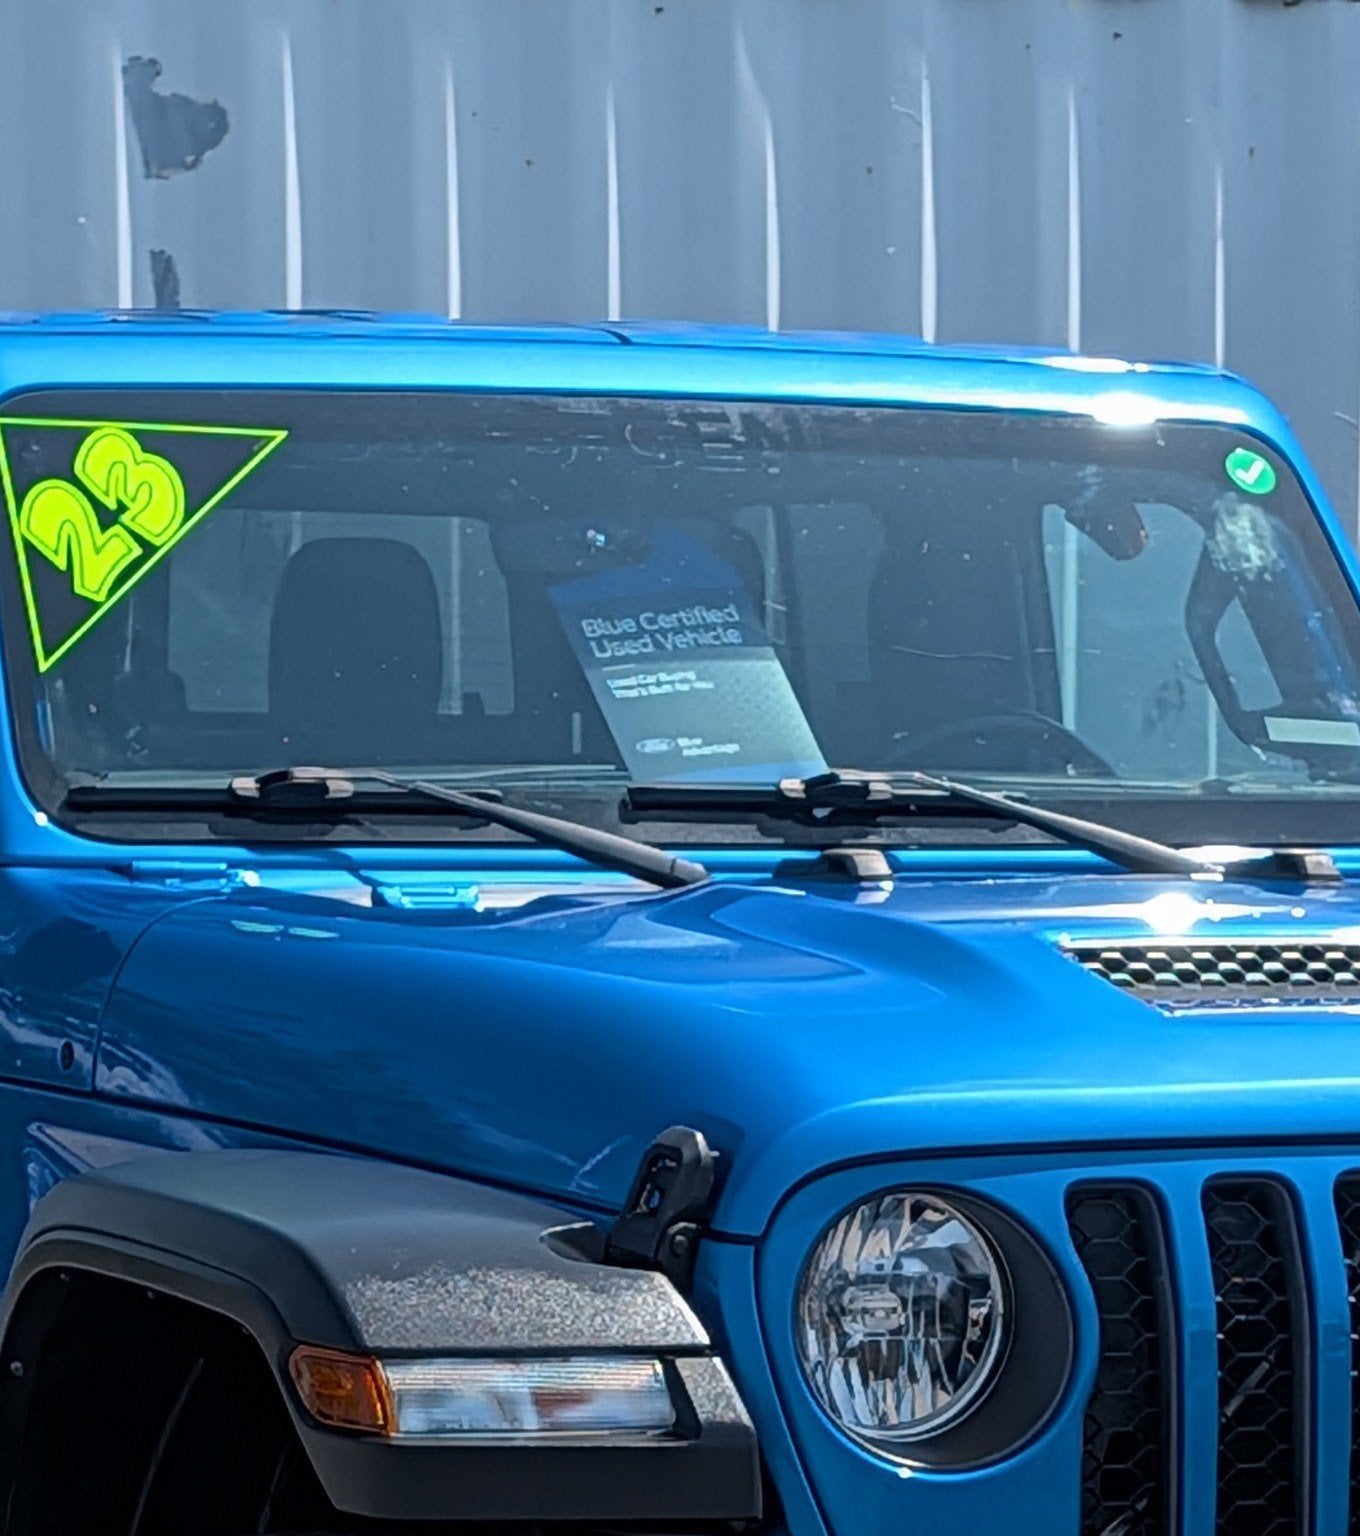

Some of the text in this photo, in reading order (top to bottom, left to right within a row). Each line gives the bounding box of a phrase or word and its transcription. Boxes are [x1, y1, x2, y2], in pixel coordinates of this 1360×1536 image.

[19, 426, 185, 602] 23
[581, 604, 740, 638] Blue Certified
[591, 626, 743, 658] Used Vehicle
